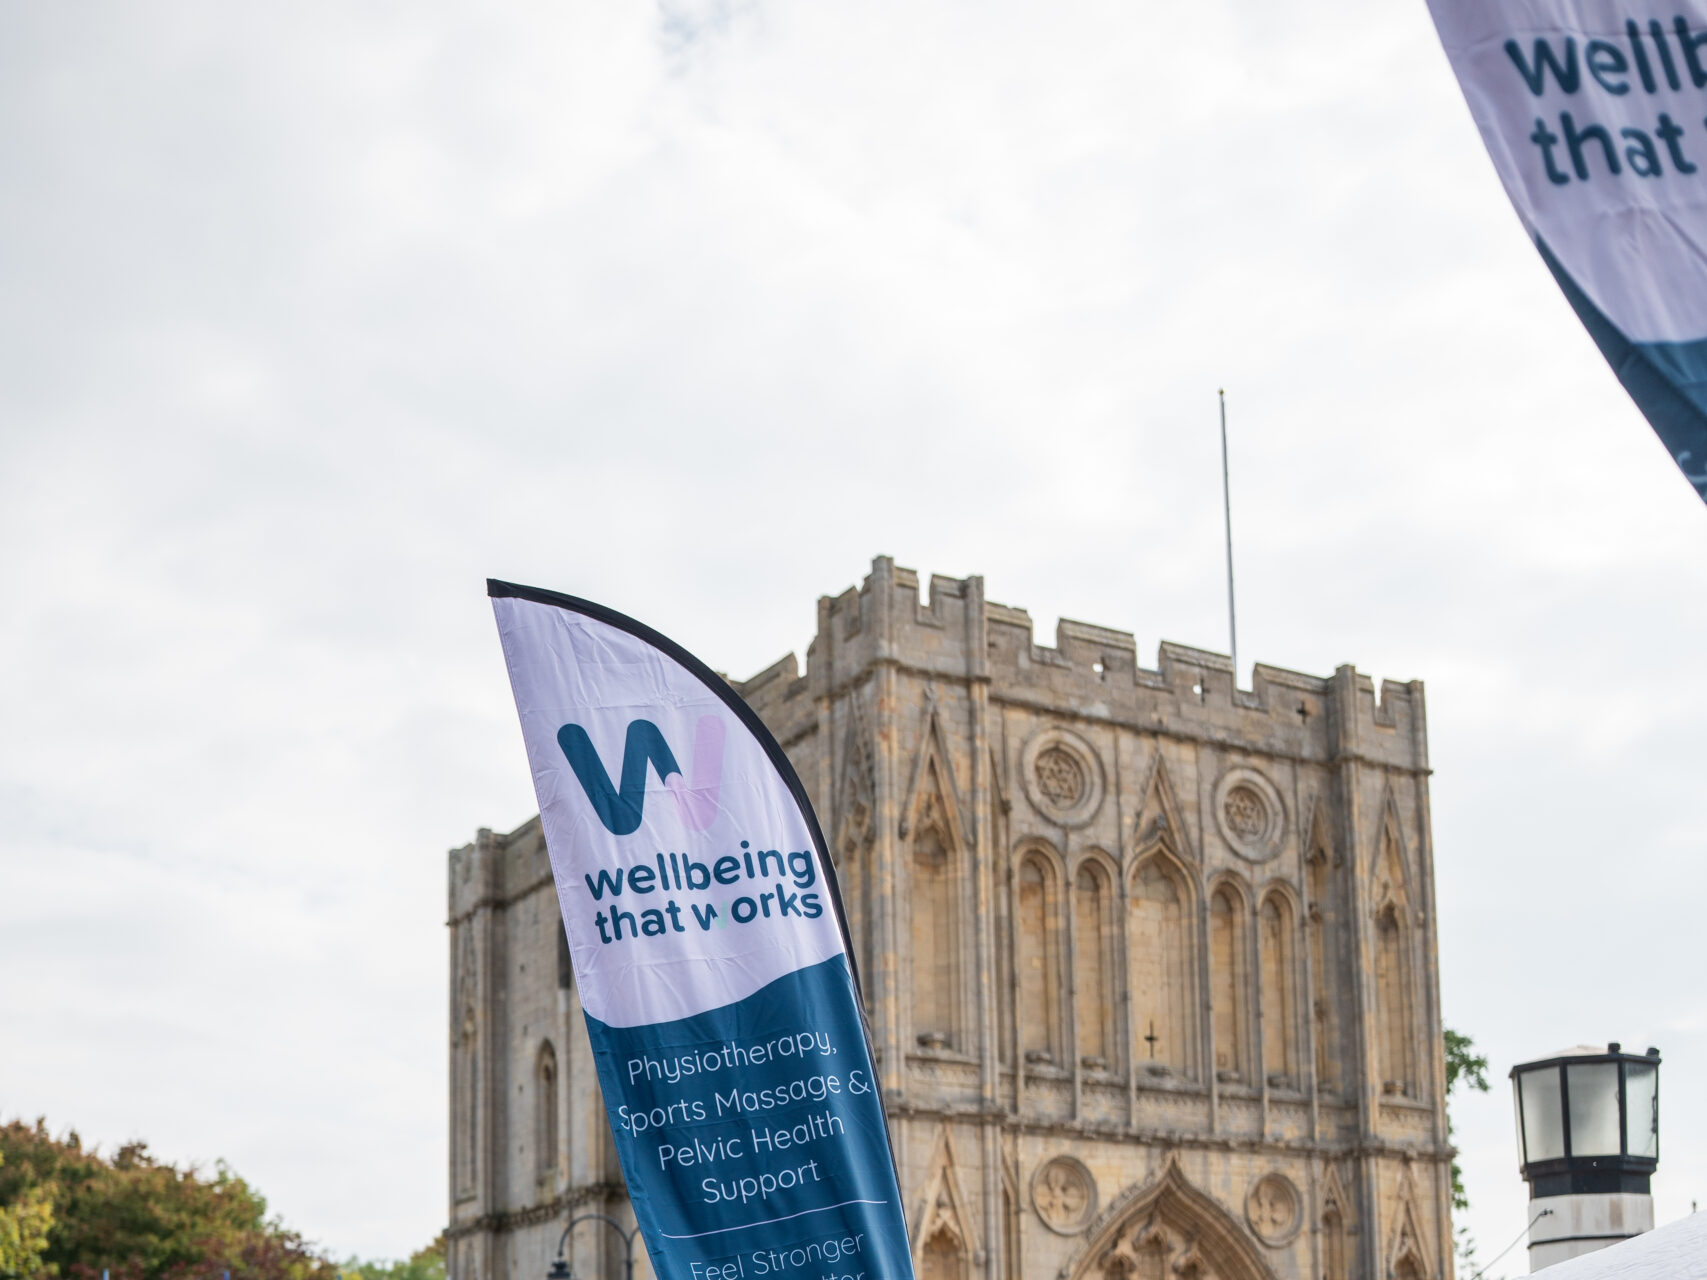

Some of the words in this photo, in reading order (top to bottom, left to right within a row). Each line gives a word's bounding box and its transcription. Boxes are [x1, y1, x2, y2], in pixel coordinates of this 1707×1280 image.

[1529, 110, 1698, 186] that
[584, 840, 817, 901] wellbeing
[595, 899, 686, 945] that
[690, 882, 824, 932] works
[626, 1031, 838, 1087] Physiotherapy,
[617, 1097, 707, 1139] Sports
[713, 1075, 842, 1118] Massage
[848, 1069, 871, 1096] &
[658, 1135, 743, 1171] Pelvic
[752, 1110, 846, 1154] Health
[702, 1158, 821, 1205] Support
[752, 1230, 865, 1277] Stronger
